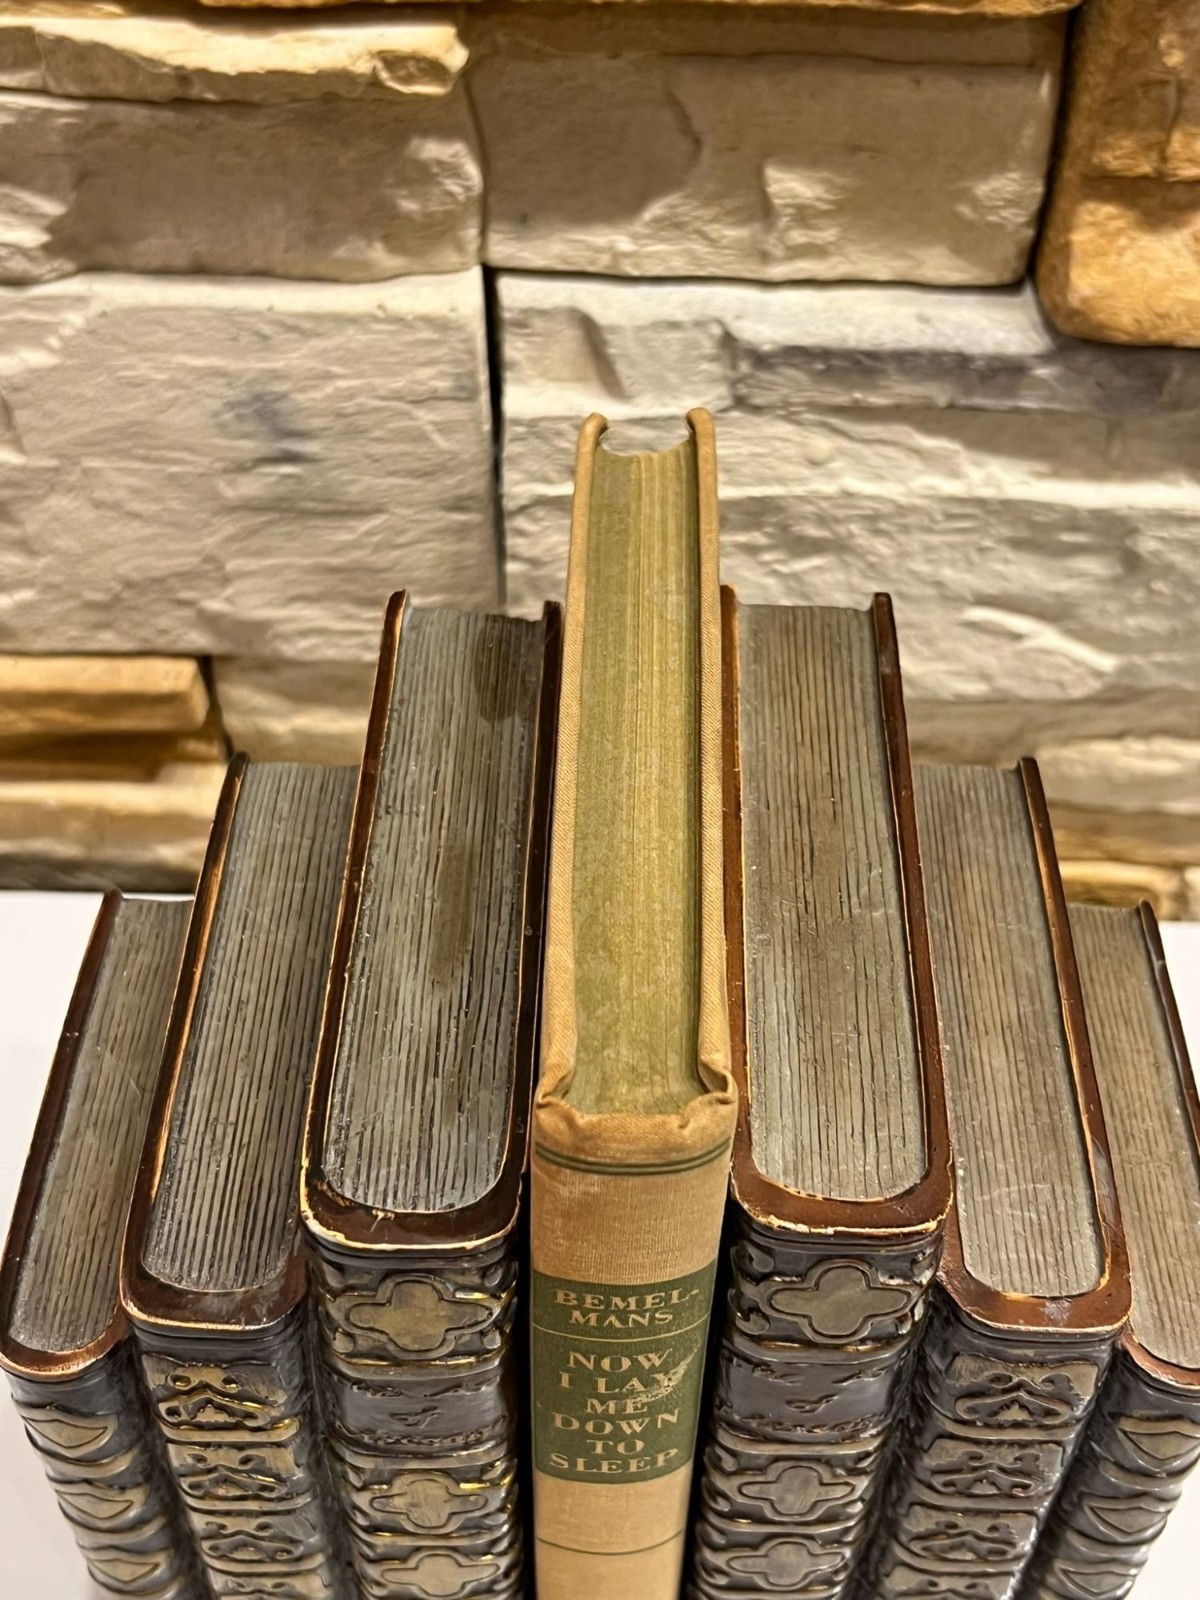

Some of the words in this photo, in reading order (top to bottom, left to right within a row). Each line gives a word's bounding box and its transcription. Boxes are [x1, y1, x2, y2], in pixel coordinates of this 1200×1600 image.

[555, 1288, 700, 1310] BEMEL-
[568, 1310, 673, 1328] MANS
[567, 1348, 672, 1372] NOW
[559, 1371, 573, 1389] I
[595, 1372, 674, 1394] LAY
[587, 1397, 648, 1415] ME
[553, 1408, 680, 1435] DOWN
[586, 1439, 645, 1455] TO
[550, 1448, 678, 1473] SLEEP
